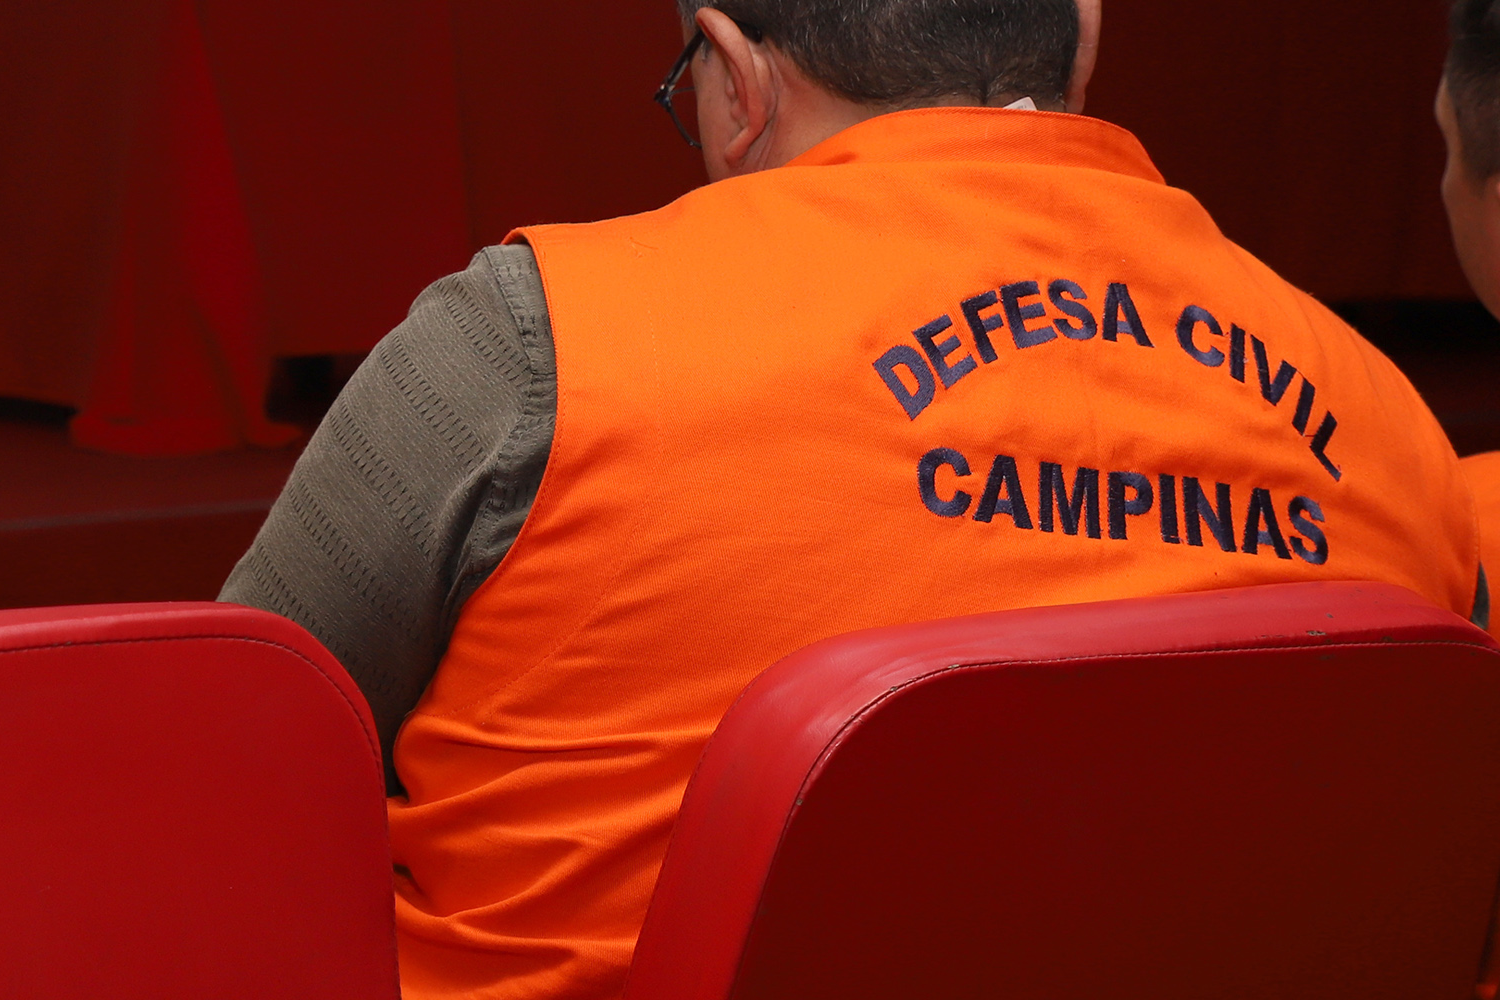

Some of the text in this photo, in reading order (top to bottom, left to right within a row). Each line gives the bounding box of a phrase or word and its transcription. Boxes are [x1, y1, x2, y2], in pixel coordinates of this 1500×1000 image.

[872, 278, 1342, 483] DEFESA CIVIL
[917, 447, 1329, 566] CAMPINAS
